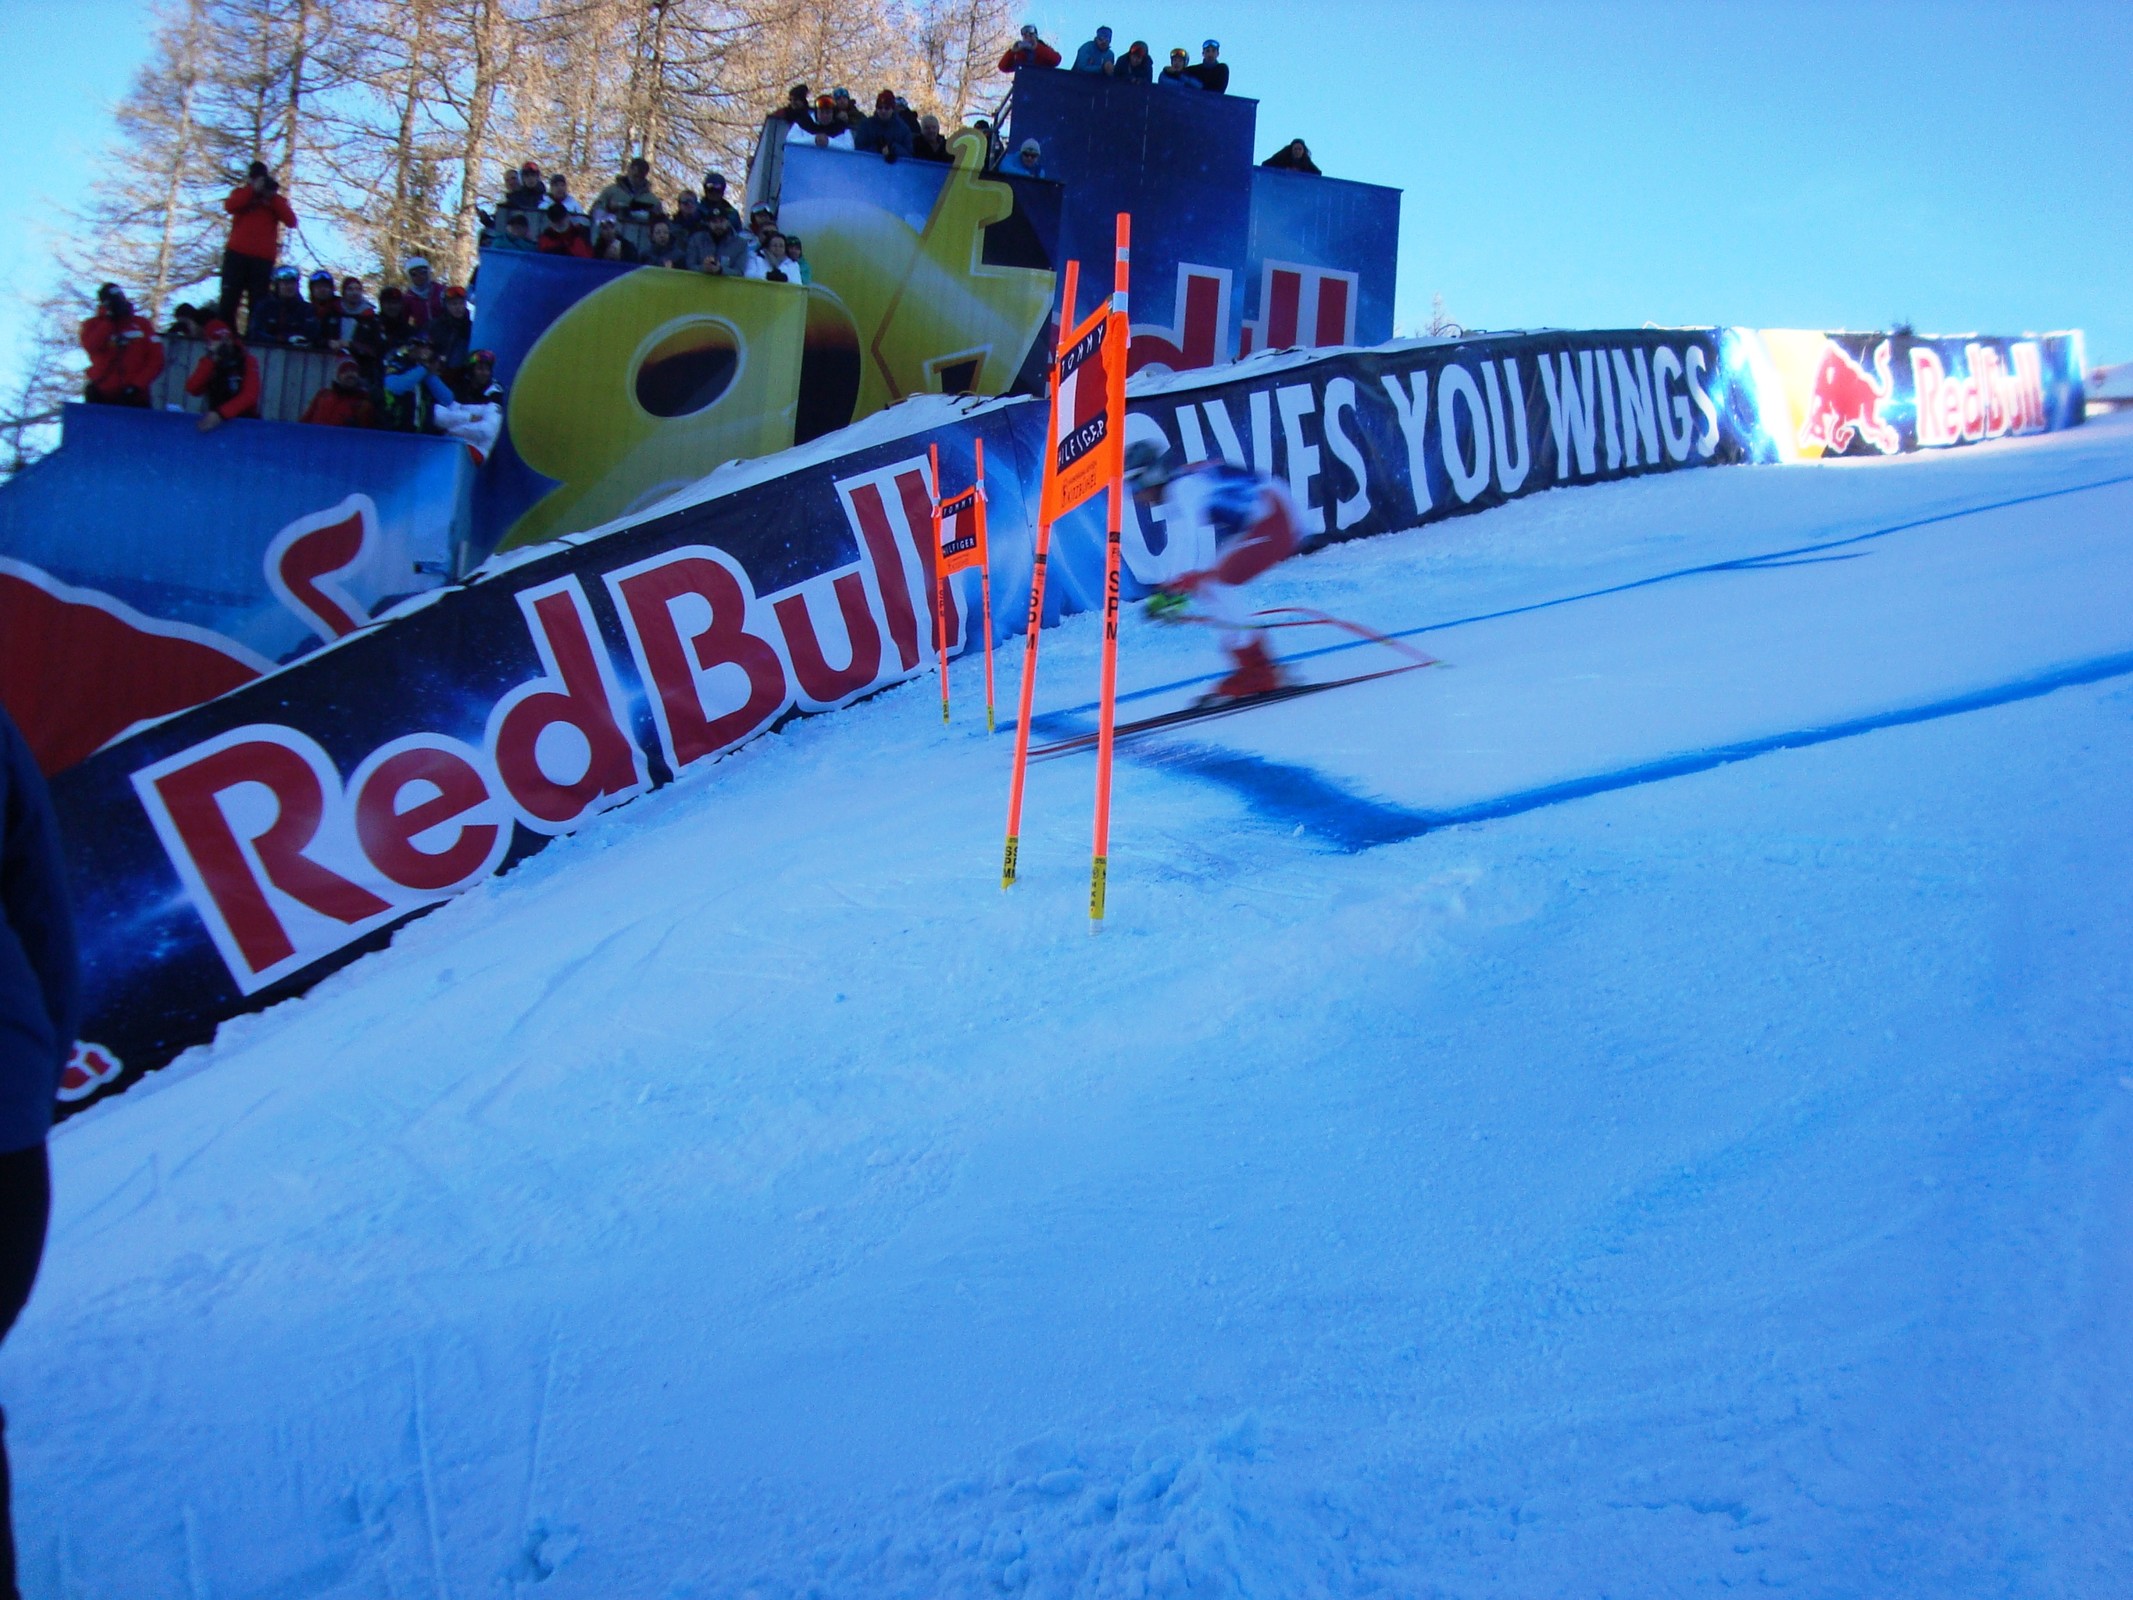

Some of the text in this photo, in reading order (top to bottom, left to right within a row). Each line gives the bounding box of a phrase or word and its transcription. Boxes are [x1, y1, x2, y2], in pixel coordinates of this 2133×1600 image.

[1060, 324, 1105, 377] TOMMY
[1909, 341, 2047, 447] Red Bull
[1057, 418, 1105, 467] HILFIGER
[1121, 344, 1720, 585] GIVES YOU WINGS
[943, 496, 974, 517] TOMMY
[943, 537, 976, 557] HILFIGER
[130, 453, 969, 996] Red Bull
